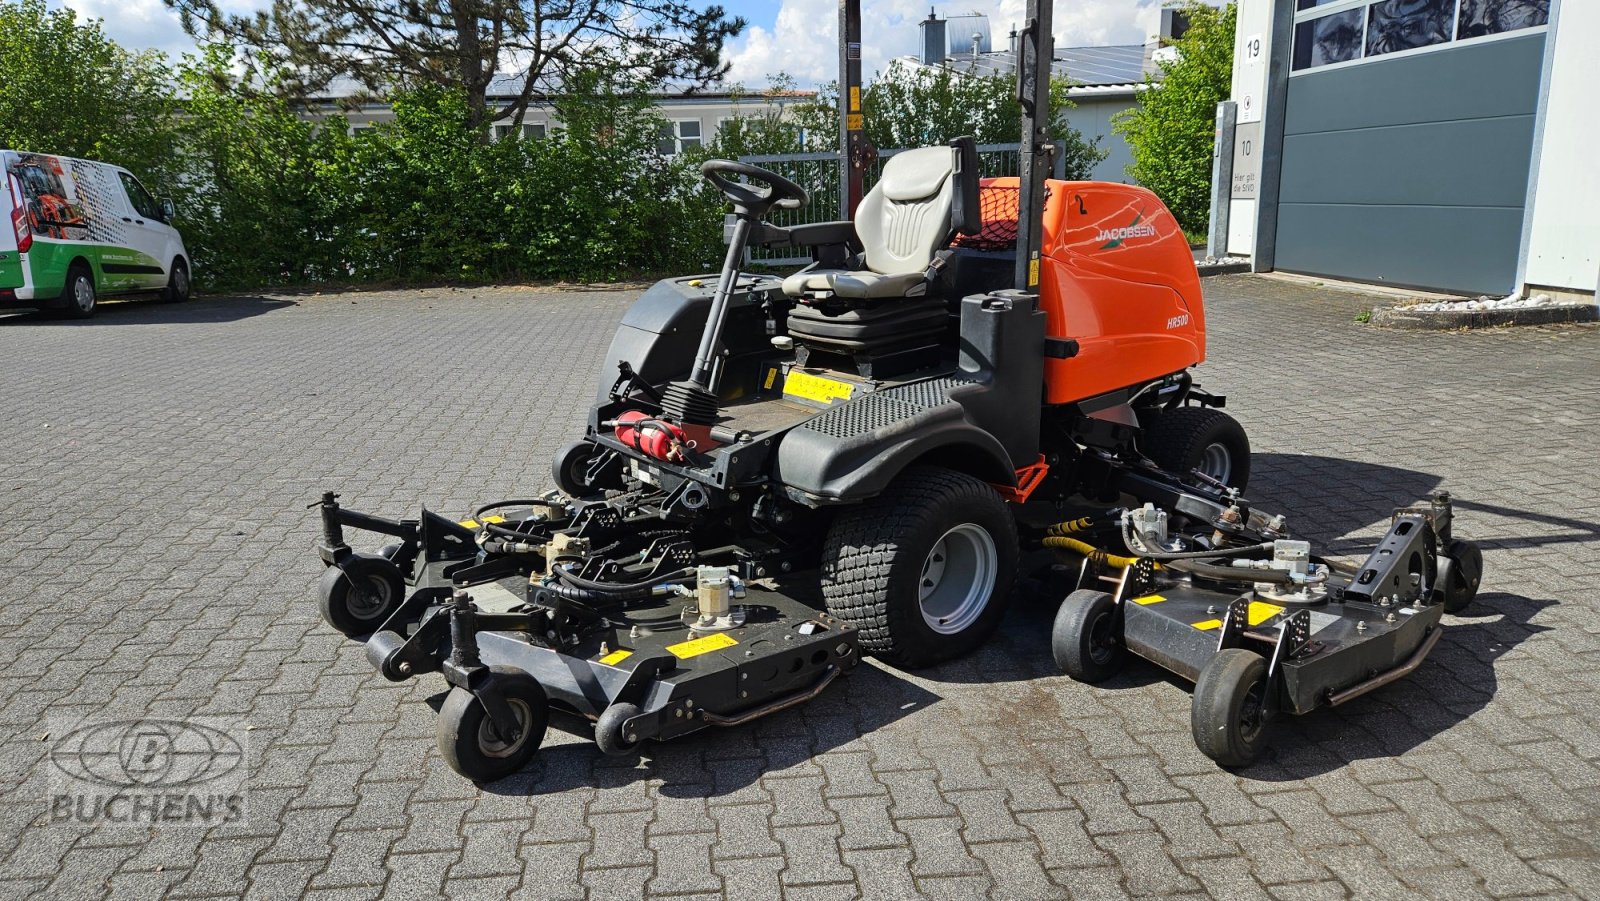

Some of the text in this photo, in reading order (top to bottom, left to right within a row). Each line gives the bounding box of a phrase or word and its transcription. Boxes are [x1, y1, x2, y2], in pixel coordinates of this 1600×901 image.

[1247, 39, 1260, 58] 19
[1242, 140, 1251, 156] 10
[1234, 173, 1255, 184] Hier gilt
[1233, 184, 1241, 192] die
[1096, 225, 1155, 241] JACOBSEN
[1166, 314, 1189, 330] HR500
